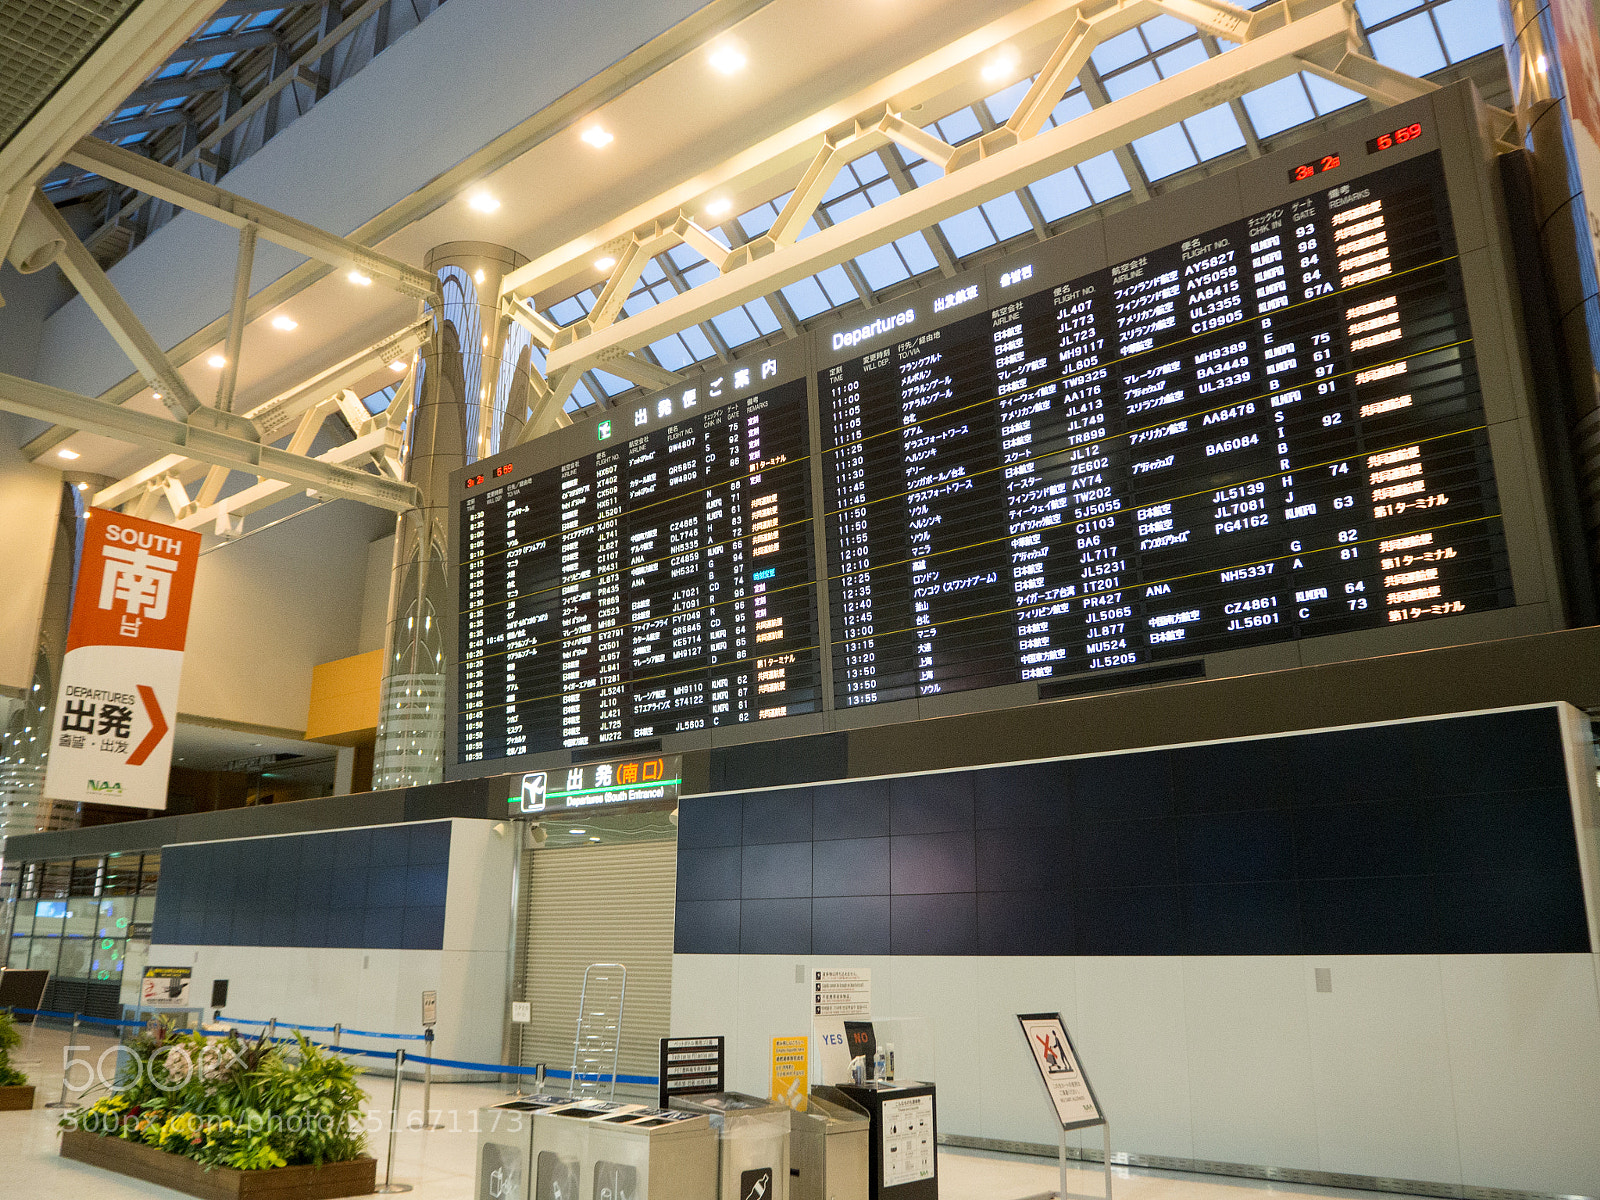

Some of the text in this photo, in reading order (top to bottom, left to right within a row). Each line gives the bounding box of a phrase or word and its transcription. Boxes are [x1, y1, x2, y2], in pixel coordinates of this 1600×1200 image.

[1292, 198, 1312, 212] ゲート
[1293, 207, 1316, 221] GATE
[1329, 188, 1370, 208] REMARKS
[1249, 219, 1281, 236] CHK IN
[1182, 238, 1230, 260] FLIGHT NO.
[1053, 284, 1070, 297] 便名
[1057, 313, 1094, 333] JL773
[1186, 265, 1237, 290] AY5059
[1297, 238, 1317, 253] 98
[1112, 267, 1143, 285] AIRLINE
[831, 380, 859, 396] 11:00
[993, 323, 1022, 342] 日本航空
[1056, 299, 1092, 320] JL407
[1184, 250, 1234, 276] AY5827
[1295, 223, 1315, 238] 93
[991, 300, 1023, 319] 航空会社
[1053, 285, 1095, 305] FLIGHT NO.
[832, 308, 916, 350] Departures
[992, 311, 1020, 327] AIRLINE
[1058, 338, 1104, 361] MH9117
[1189, 294, 1241, 319] UL3355
[1302, 268, 1321, 283] 84
[833, 404, 860, 421] 11:05
[1059, 327, 1096, 347] JL723
[1188, 279, 1239, 305] AA8415
[834, 281, 1334, 446] 11:15 台北 JL805 CI9905 67A
[863, 357, 890, 372] WILL DEP.
[897, 347, 920, 360] TO/VIA
[829, 373, 843, 384] TIME
[1062, 367, 1107, 388] TW9325
[835, 455, 863, 471] 11:30
[1063, 384, 1101, 404] AA176
[1194, 340, 1247, 364] MH9389
[836, 331, 1330, 483] 11:30 JL413 BA3449 75
[1067, 427, 1106, 445] TR899
[1315, 363, 1334, 377] 97
[837, 371, 1251, 495] 11:45 JL749 UL3339
[838, 402, 1255, 522] 11:50 JL12 AA8478
[1070, 457, 1109, 475] ZE602
[839, 412, 1342, 547] 11:55 AY74 BA6084 92
[840, 486, 1111, 560] 12:00 TW202
[841, 462, 1349, 586] 12:25 CI103 JL5139 74
[841, 498, 1121, 573] 12:10 マニラ 5J5055
[105, 524, 182, 556] SOUTH
[670, 527, 742, 554] NH5335 72
[912, 497, 1265, 584] ロンドン BA6 JL7081
[843, 513, 1269, 612] 12:40 JL717 PG4162
[1014, 576, 1045, 592] 日本航空
[1080, 559, 1125, 578] JL5231
[1082, 547, 1358, 608] PR427 ANA NH5337 81
[98, 544, 179, 621] 南
[672, 586, 699, 600] JL7021
[672, 598, 699, 612] JL7091
[672, 610, 700, 624] FY7049
[844, 576, 1119, 638] 13:00 IT201
[119, 614, 143, 638] 남
[672, 634, 701, 647] KE5714
[846, 606, 1132, 665] 13:20 JL5065
[918, 596, 1277, 667] 上海 JL877 CZ4861
[1086, 597, 1367, 654] MU524 JL5601 73
[847, 652, 1137, 705] 13:55 JL5205
[66, 685, 135, 705] DEPARTURES
[61, 699, 133, 738] 出発
[675, 719, 704, 731] JL5603
[822, 1034, 843, 1046] YES
[854, 1032, 868, 1044] NO
